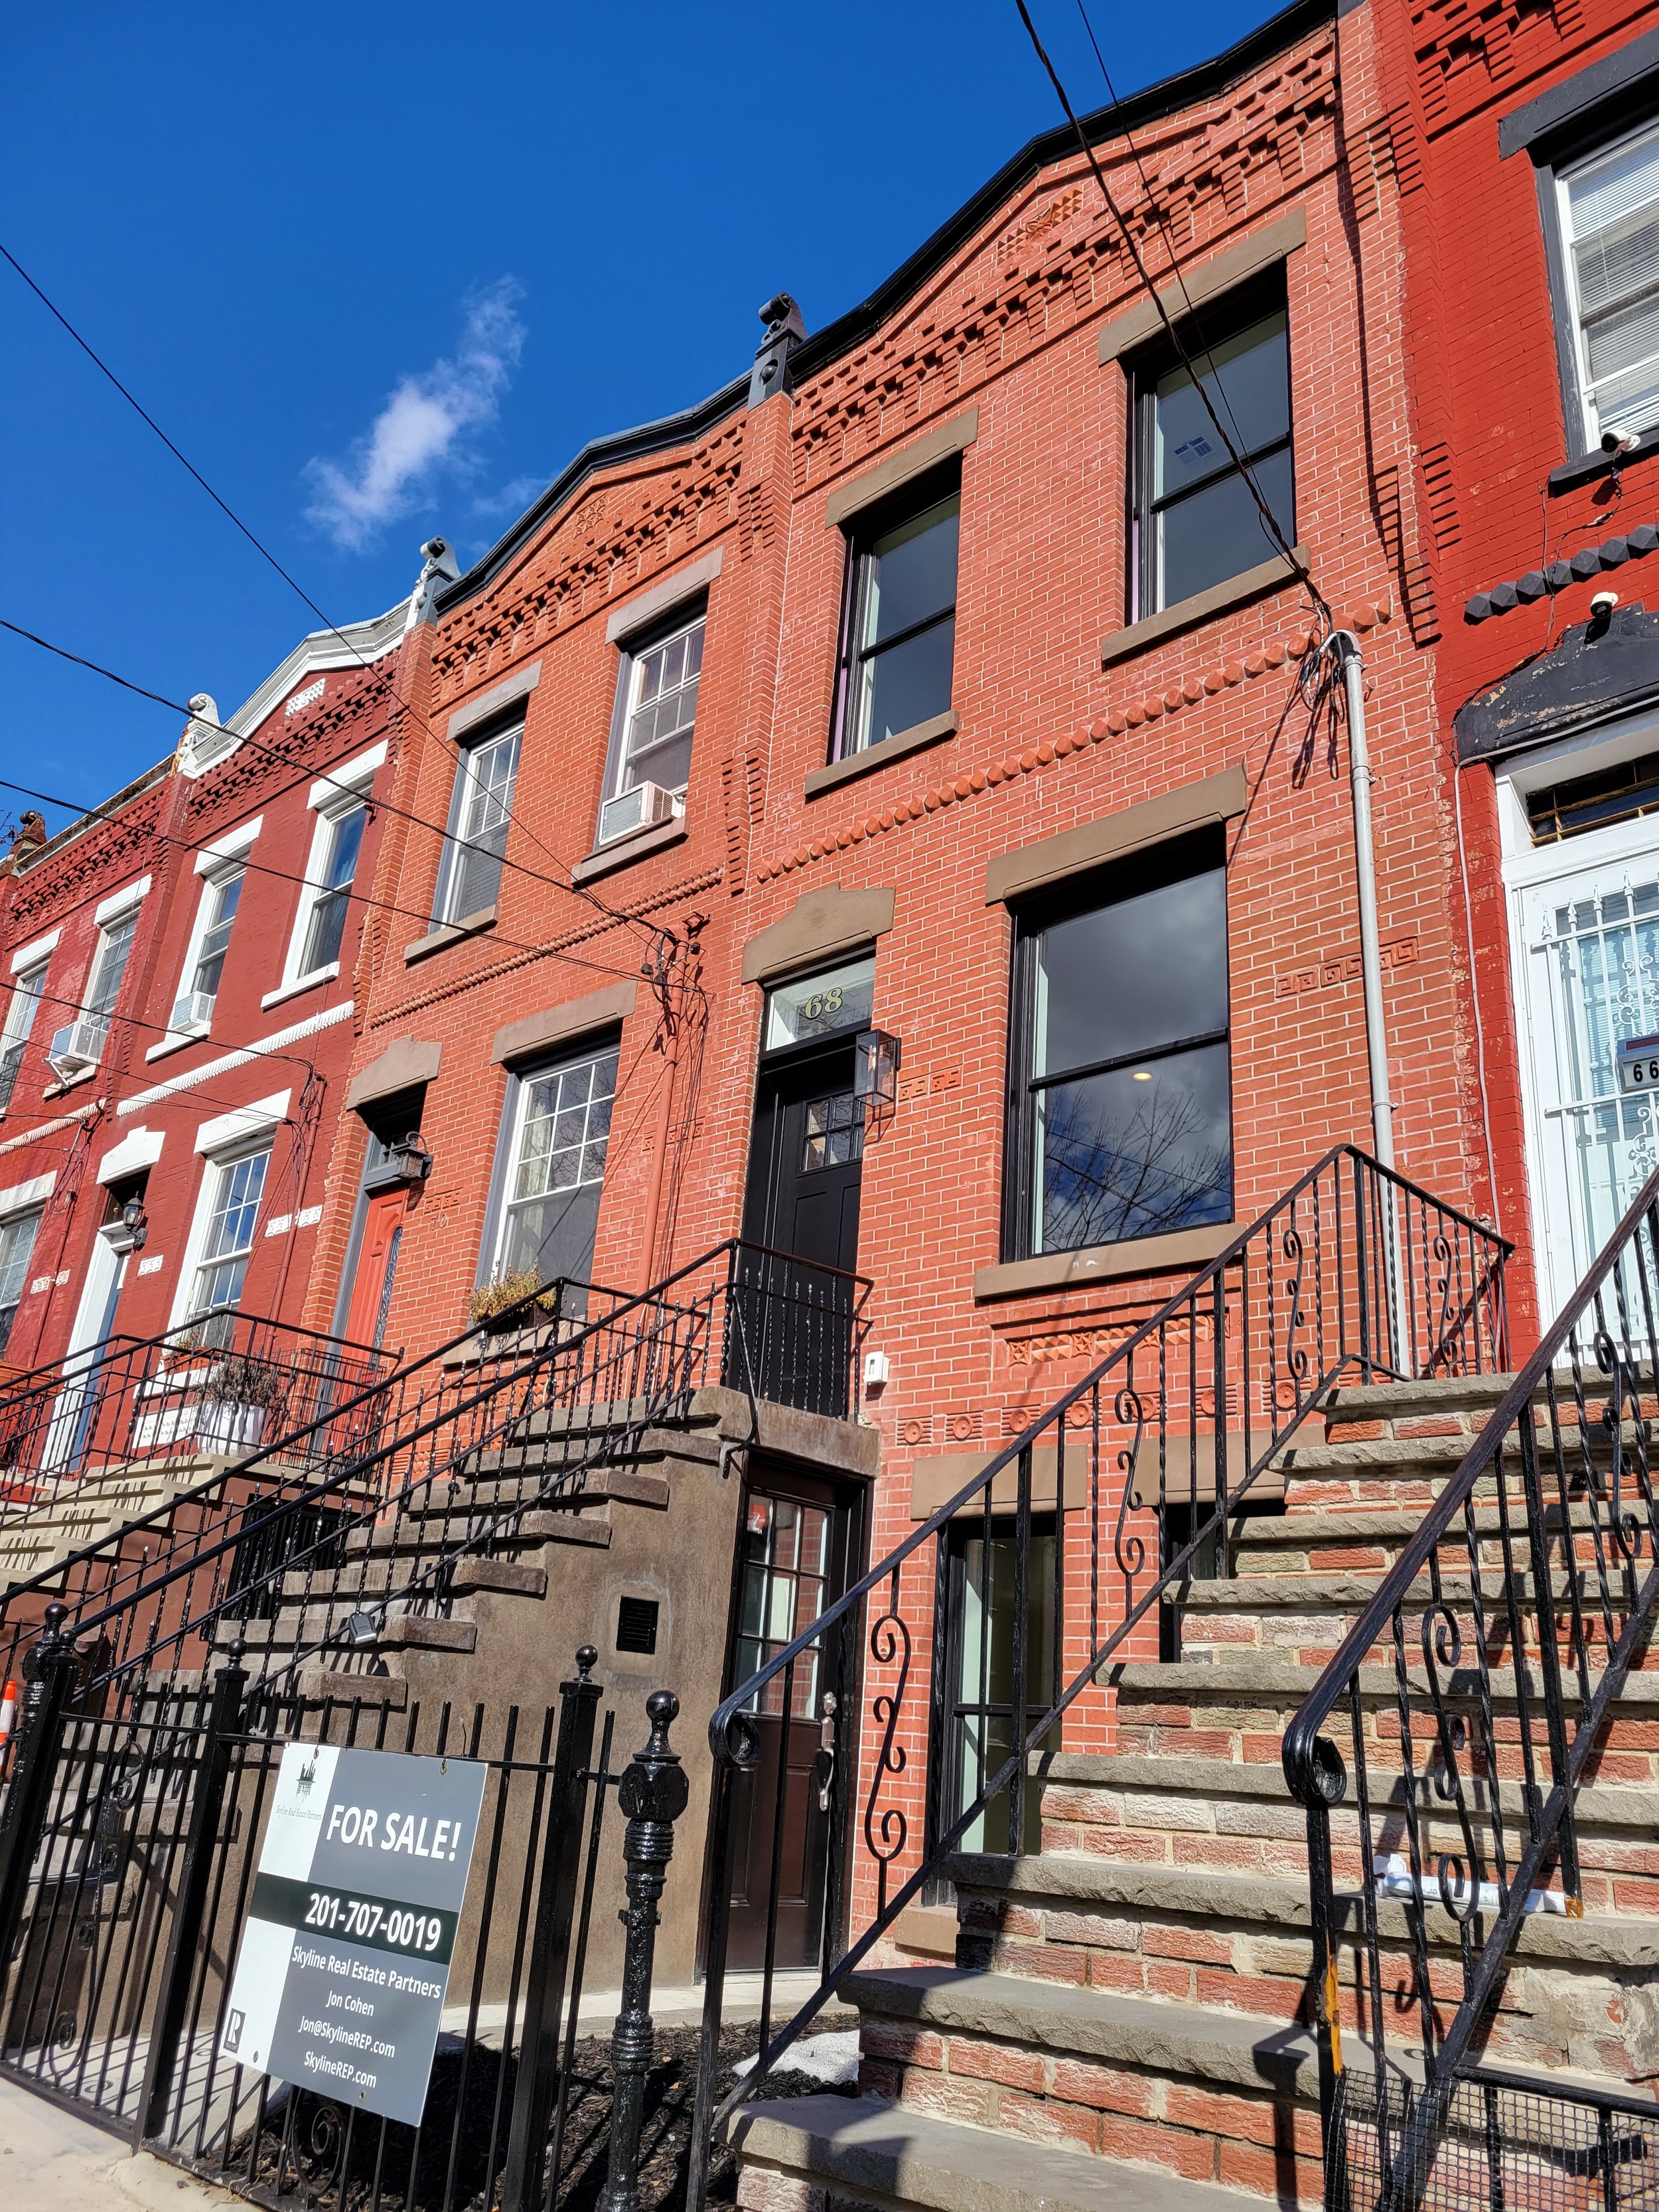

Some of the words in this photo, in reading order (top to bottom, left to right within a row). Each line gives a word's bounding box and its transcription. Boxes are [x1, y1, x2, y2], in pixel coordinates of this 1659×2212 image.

[804, 987, 843, 1019] 68
[1633, 1060, 1659, 1082] 66
[326, 1804, 378, 1848] FOR
[380, 1812, 462, 1862] SALE!
[305, 1893, 441, 1951] 201-707-0019
[292, 1945, 326, 1970] Skyline
[327, 1955, 351, 1976] Real
[351, 1961, 386, 1986] Estate
[388, 1970, 441, 1999] Partners
[325, 1990, 343, 2008] Jon
[344, 1995, 374, 2017] Cohen
[298, 2015, 396, 2058] Jon@SkylineREP.com
[304, 2051, 377, 2089] SkylineREP.com
